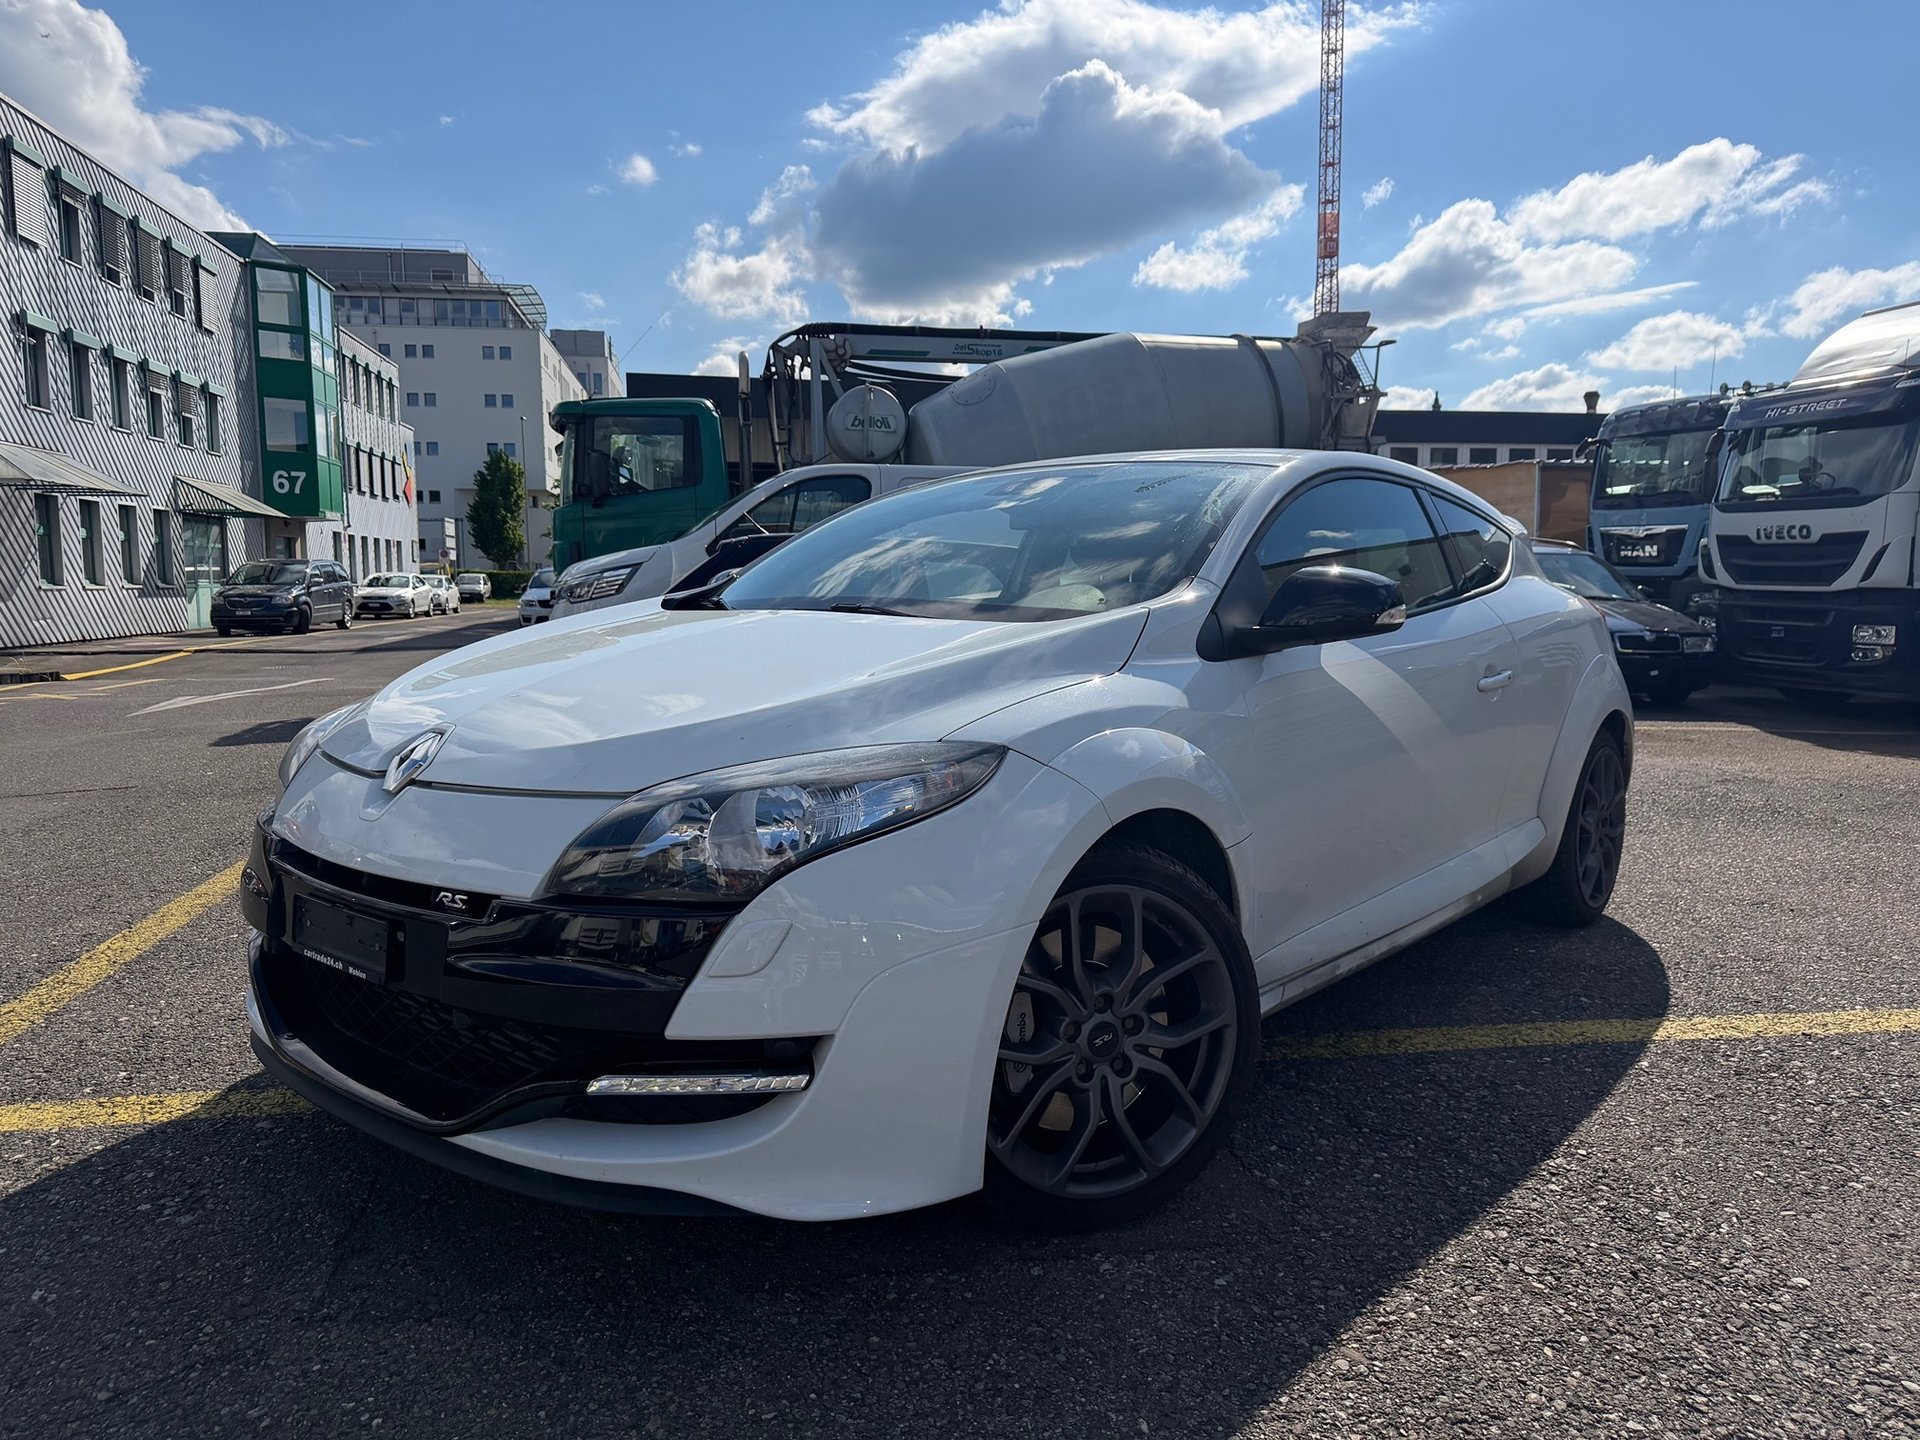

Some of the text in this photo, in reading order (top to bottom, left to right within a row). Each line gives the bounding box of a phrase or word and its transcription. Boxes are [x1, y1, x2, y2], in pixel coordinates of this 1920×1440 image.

[1764, 398, 1849, 419] HI-STREET
[272, 469, 307, 494] 67
[1756, 525, 1812, 540] IVECO
[1620, 544, 1658, 557] MAN
[303, 948, 367, 980] cartrade24.ch Wohlen
